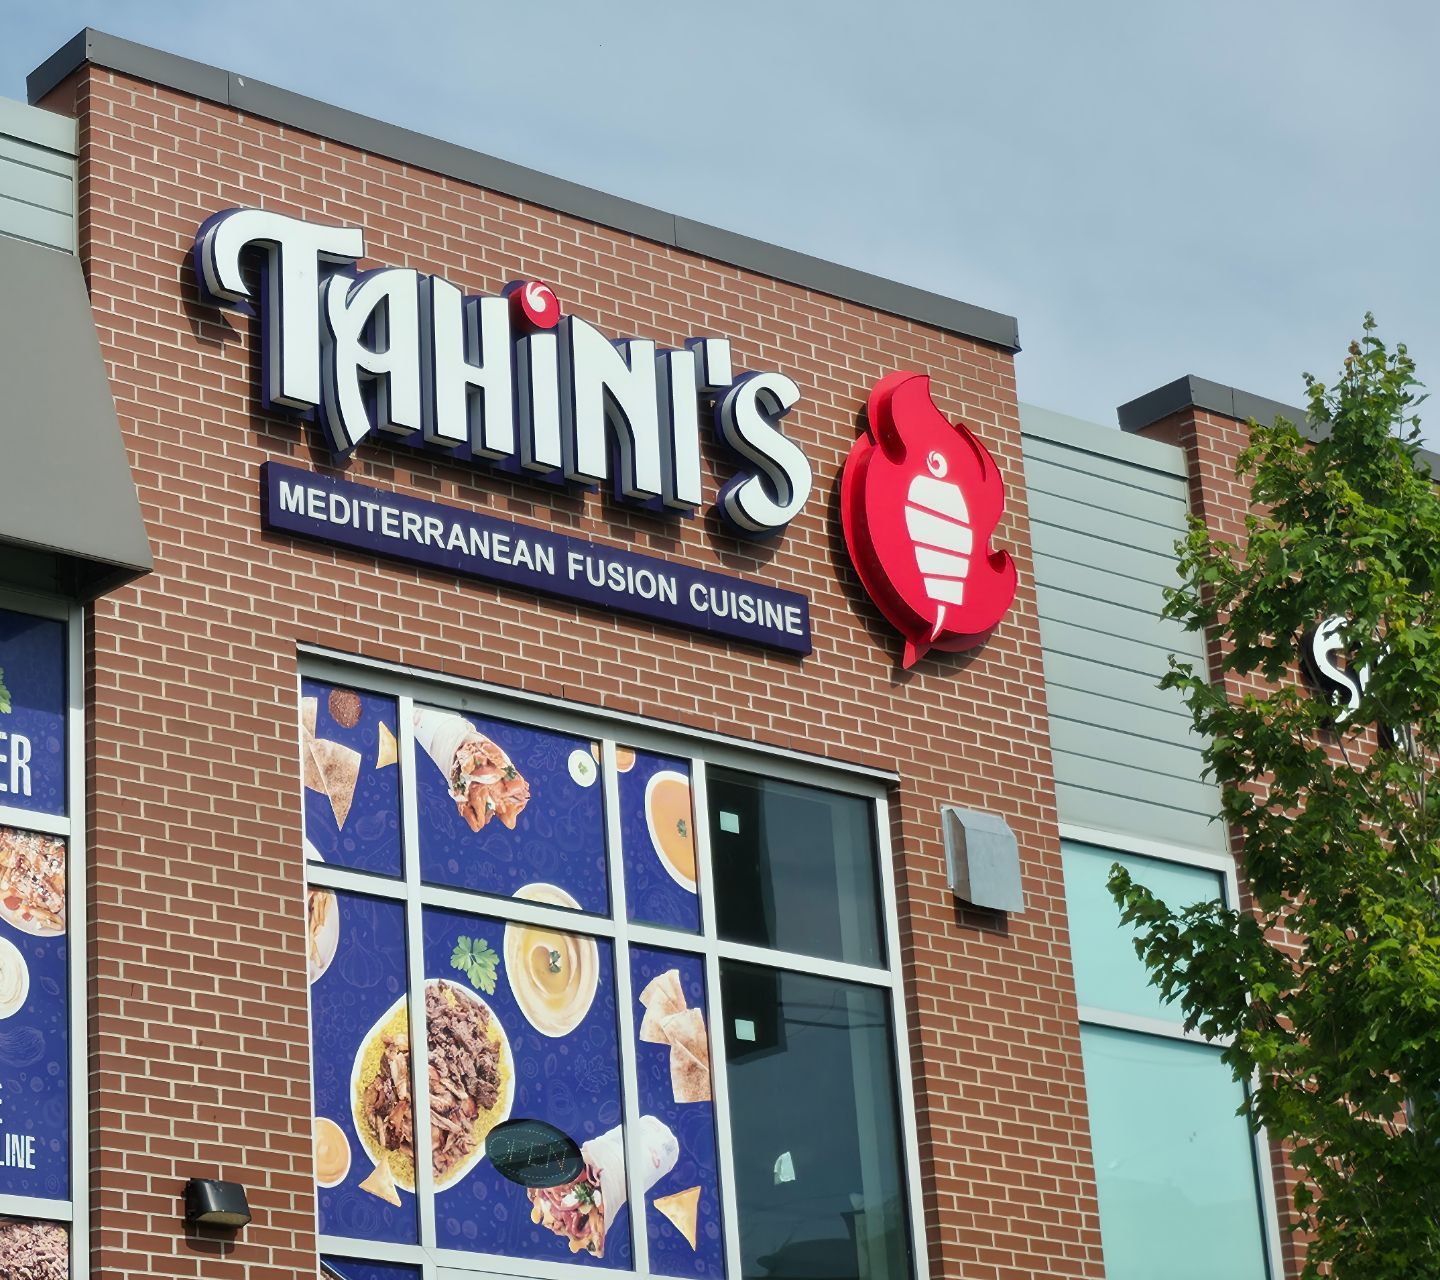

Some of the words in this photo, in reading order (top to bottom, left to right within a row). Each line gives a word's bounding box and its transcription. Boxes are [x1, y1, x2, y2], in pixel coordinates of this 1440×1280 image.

[278, 480, 557, 576] MEDITERRANEAN
[567, 551, 679, 606] FUSION
[689, 582, 804, 637] CUISINE
[489, 1136, 568, 1174] OPEN
